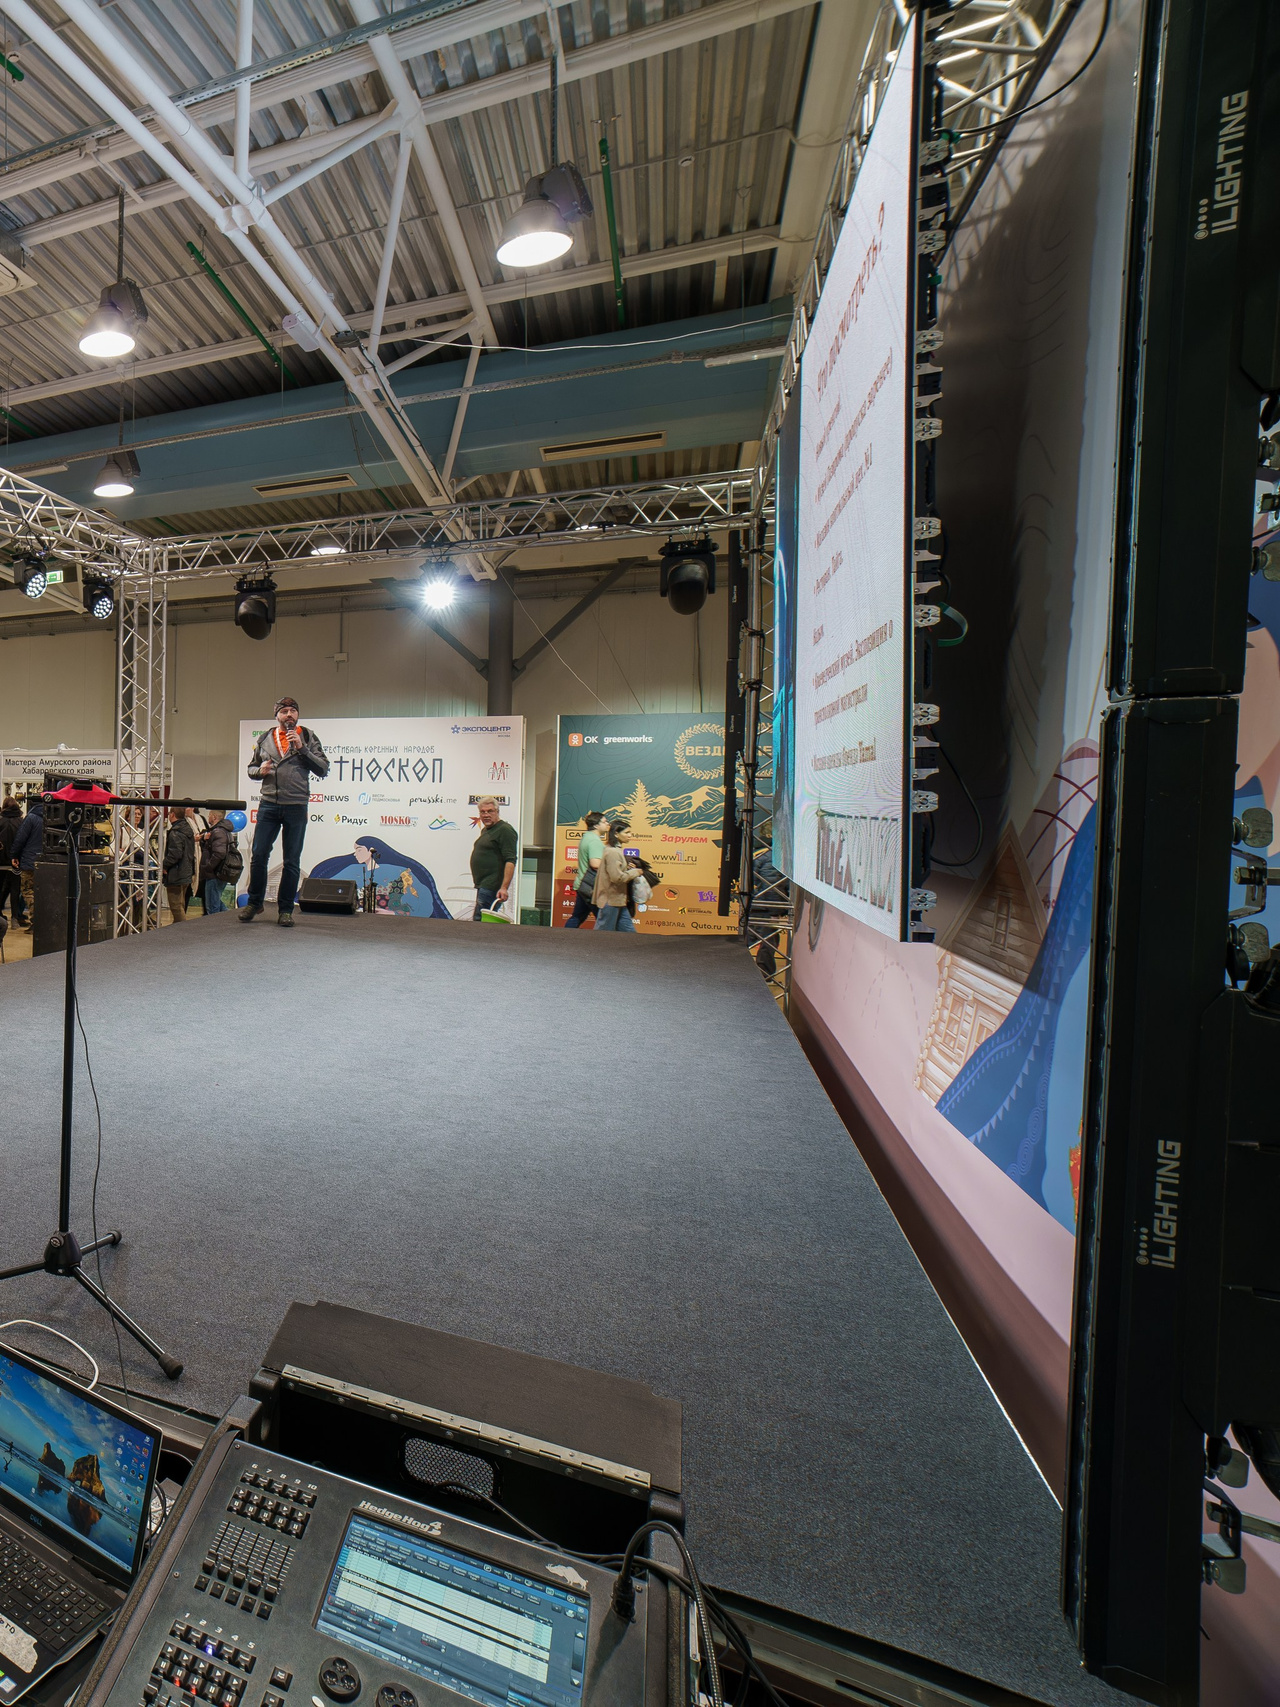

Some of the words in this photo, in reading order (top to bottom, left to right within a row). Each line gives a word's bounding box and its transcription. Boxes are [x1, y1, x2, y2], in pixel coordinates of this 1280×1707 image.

[1211, 90, 1249, 235] ILIGHTING
[584, 736, 599, 744] OK
[603, 735, 653, 745] greenworks
[5, 759, 36, 768] Мастера
[39, 758, 80, 768] Амурского
[82, 757, 112, 768] района
[77, 767, 95, 775] края
[332, 756, 443, 784] ТНОСКОП
[341, 815, 368, 826] Ридус
[690, 921, 722, 931] Quto.ru
